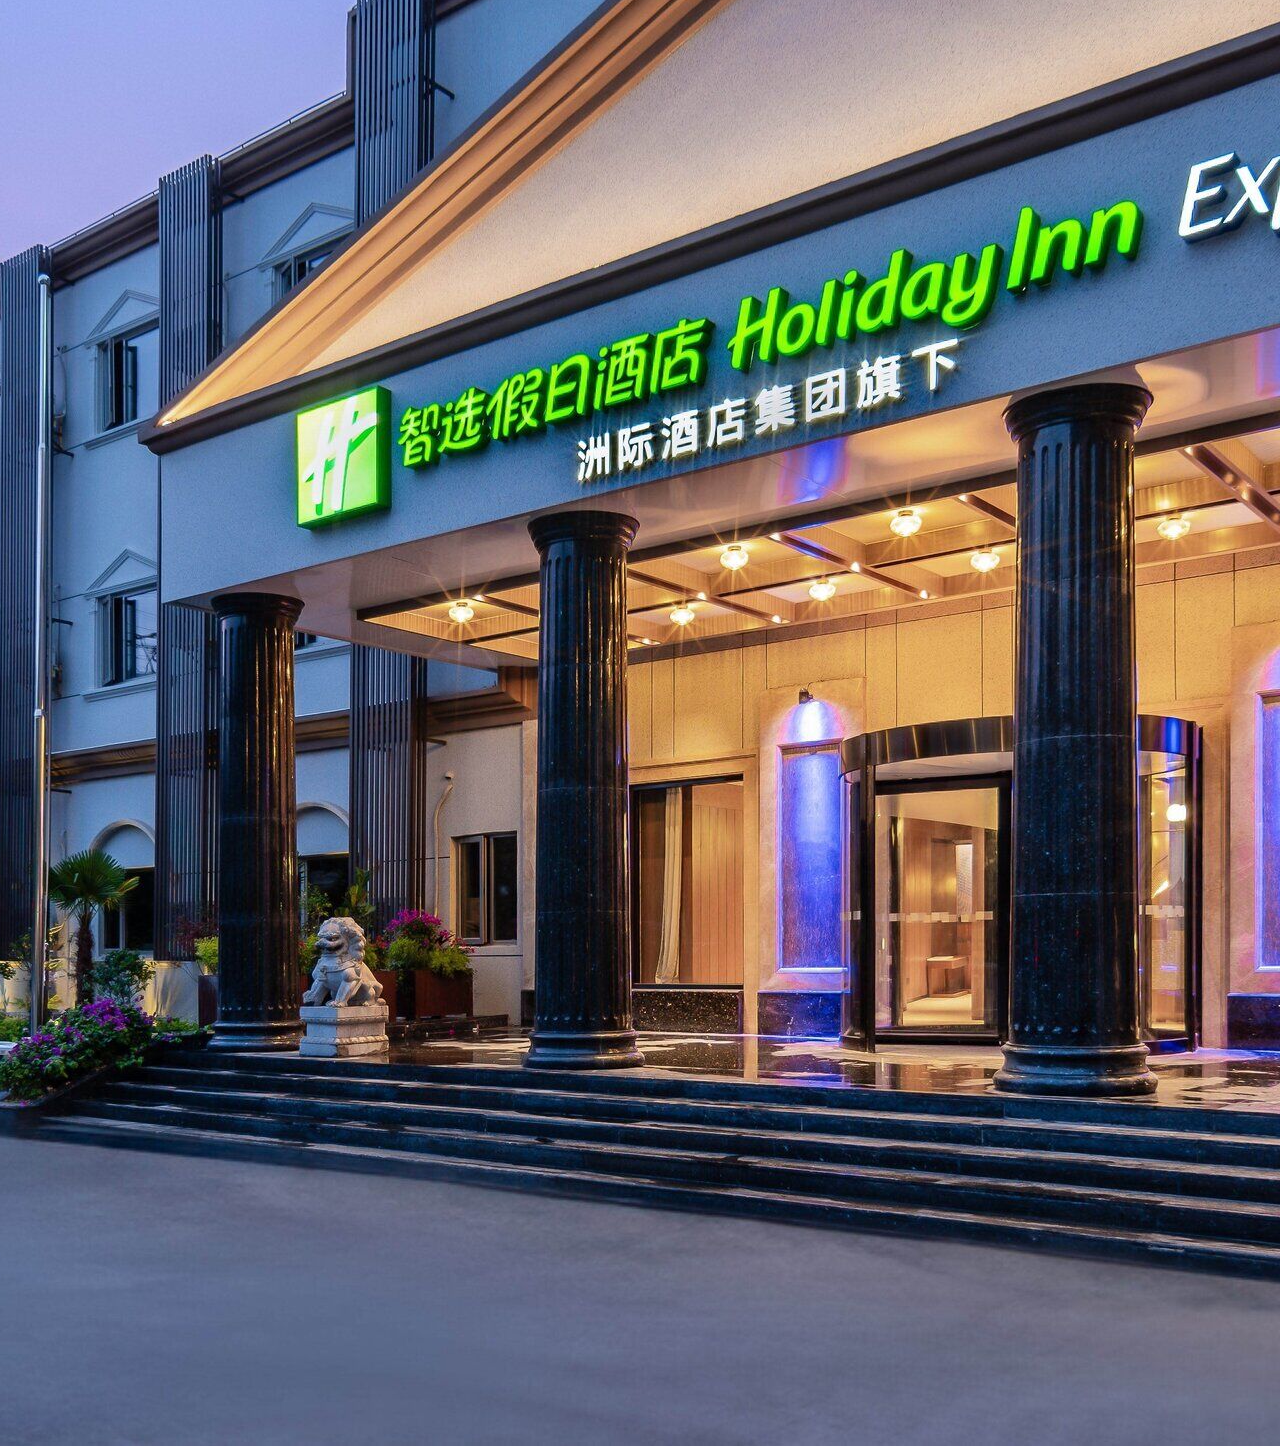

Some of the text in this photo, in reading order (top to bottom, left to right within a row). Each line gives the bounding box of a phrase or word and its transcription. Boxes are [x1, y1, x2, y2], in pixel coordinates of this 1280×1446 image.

[728, 243, 1001, 371] Holiday
[1006, 200, 1144, 296] Inn
[398, 319, 710, 468] 智选假日酒店
[577, 337, 961, 482] 洲际酒店集团旗下
